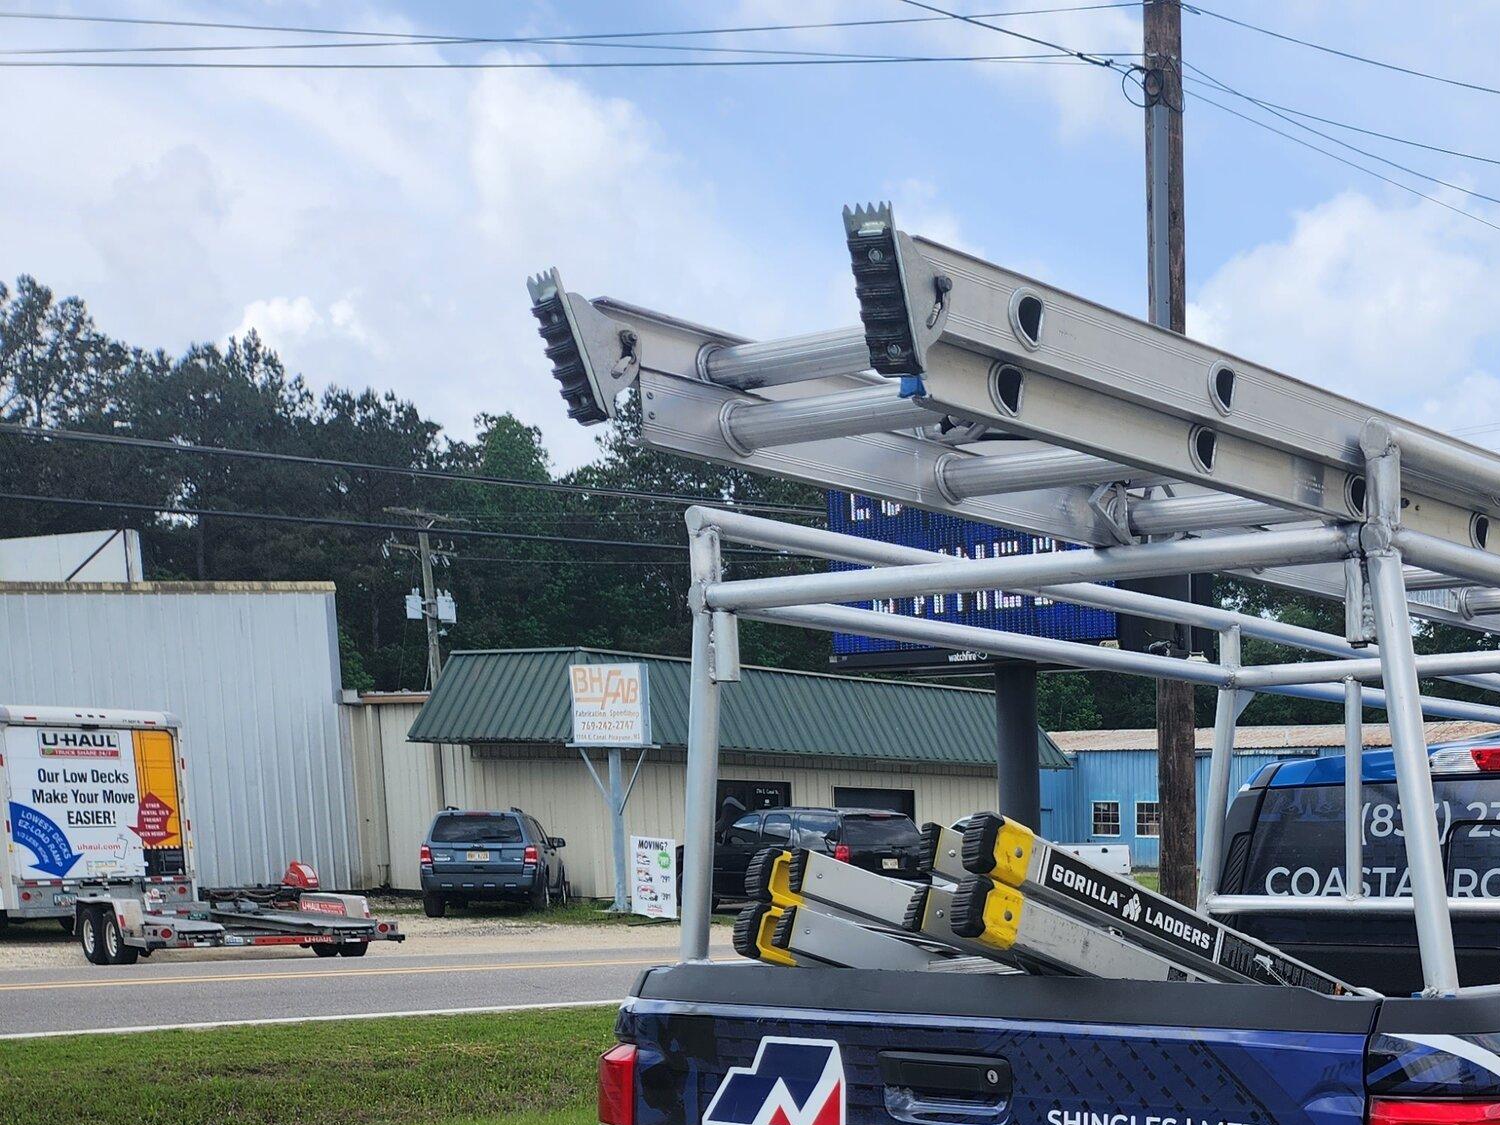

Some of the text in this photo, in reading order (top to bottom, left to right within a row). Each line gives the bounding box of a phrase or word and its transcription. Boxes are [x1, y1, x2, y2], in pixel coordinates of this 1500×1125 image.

[948, 652, 977, 662] watchfire
[573, 667, 639, 710] BH FAB
[582, 720, 634, 730] 769-242-2747
[41, 732, 117, 748] U-HAUL
[38, 768, 129, 784] Our Low Decks
[32, 789, 135, 804] Make Your Move
[67, 810, 117, 825] EASIER!
[1361, 800, 1452, 846] (8)
[21, 810, 54, 833] LOWEST
[51, 832, 72, 860] DECKS
[17, 819, 63, 868] EZ-LOAD RAMP
[77, 842, 121, 851] uhaul.com
[638, 839, 668, 851] MOVING?
[1051, 863, 1211, 950] GORILLA LADDERS
